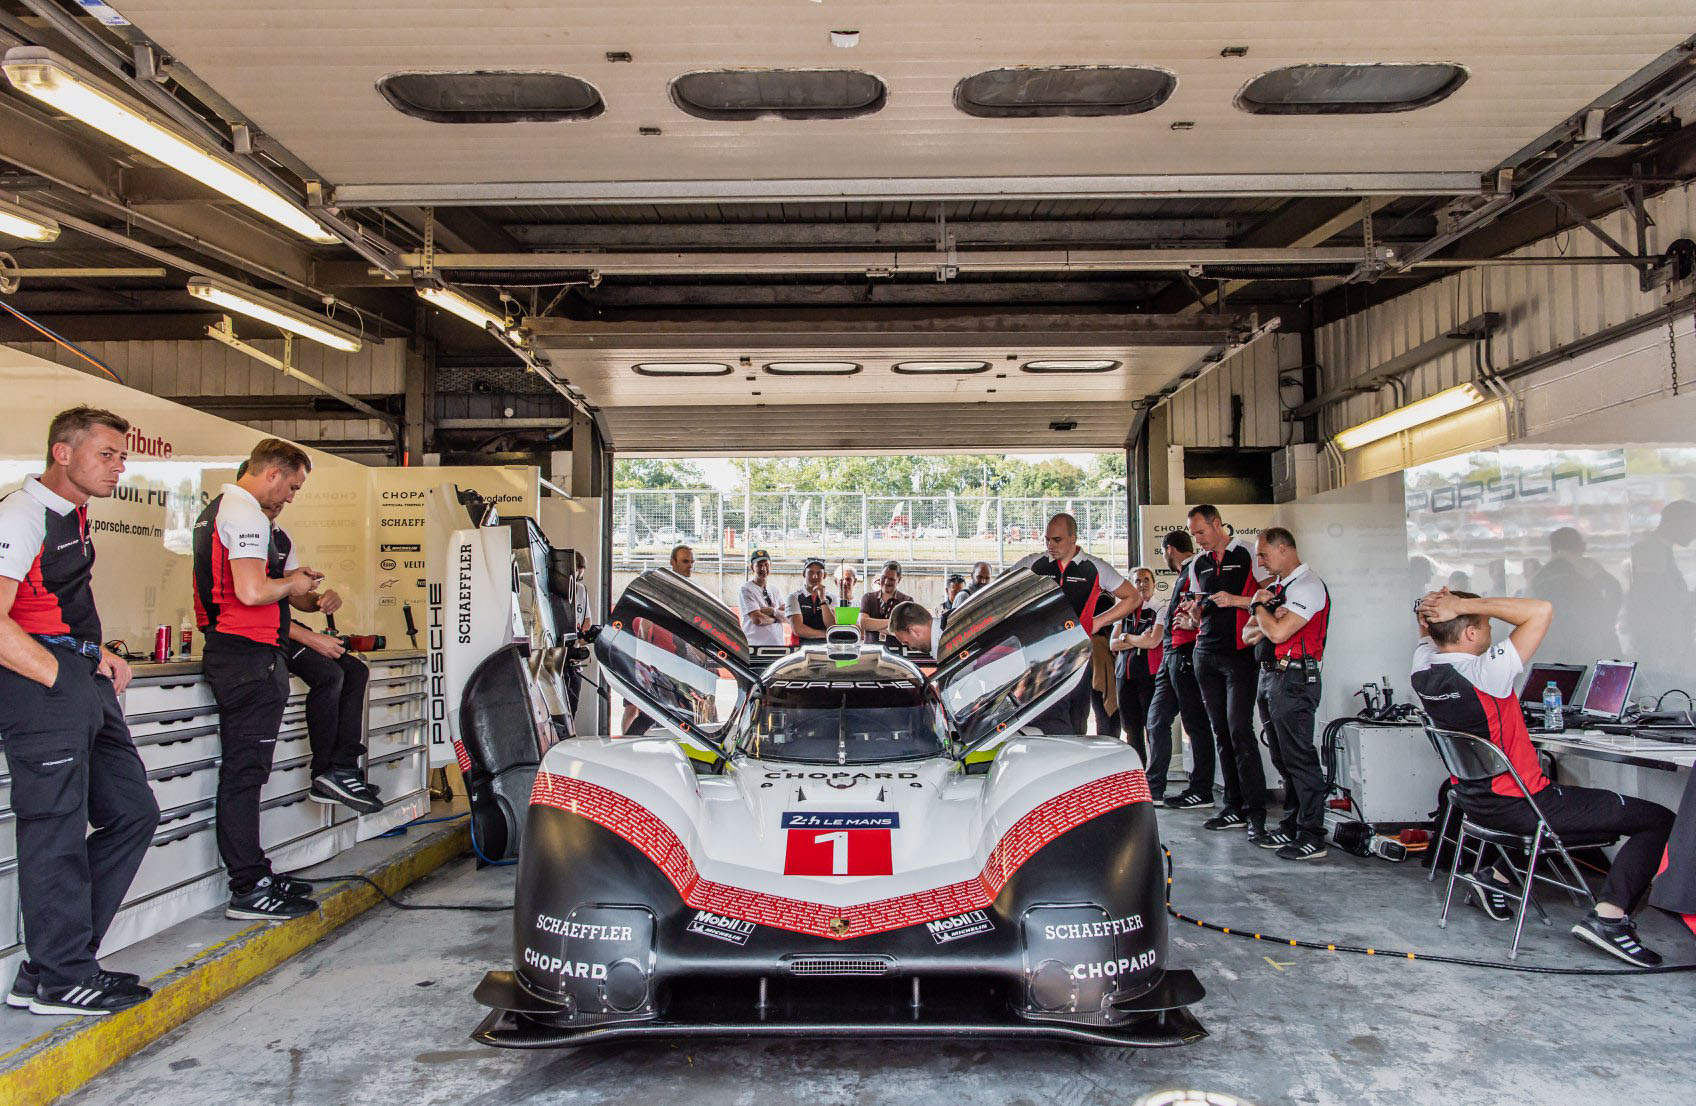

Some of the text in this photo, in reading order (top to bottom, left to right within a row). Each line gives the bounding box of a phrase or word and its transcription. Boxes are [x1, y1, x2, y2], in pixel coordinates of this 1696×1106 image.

[125, 427, 172, 459] ribute
[382, 491, 425, 500] CHOPA
[483, 494, 523, 503] vodafone
[381, 518, 425, 527] SCHAEFF
[1236, 527, 1262, 535] vodafo
[404, 560, 425, 569] VELTI
[458, 543, 472, 644] SCHAEFFLER
[429, 582, 445, 745] PORSCHE
[769, 681, 916, 689] PORSCHE
[846, 818, 892, 826] MANS
[814, 831, 849, 875] 1
[536, 914, 633, 941] SCHAEFFLER
[694, 910, 741, 930] Mobil
[925, 914, 973, 933] Mobil
[1045, 914, 1144, 940] SCHAEFFLER
[705, 926, 743, 941] MICHELIN
[951, 924, 988, 937] MICHELIN
[524, 947, 607, 980] CHOPARD
[1073, 949, 1156, 980] CHOPARD
